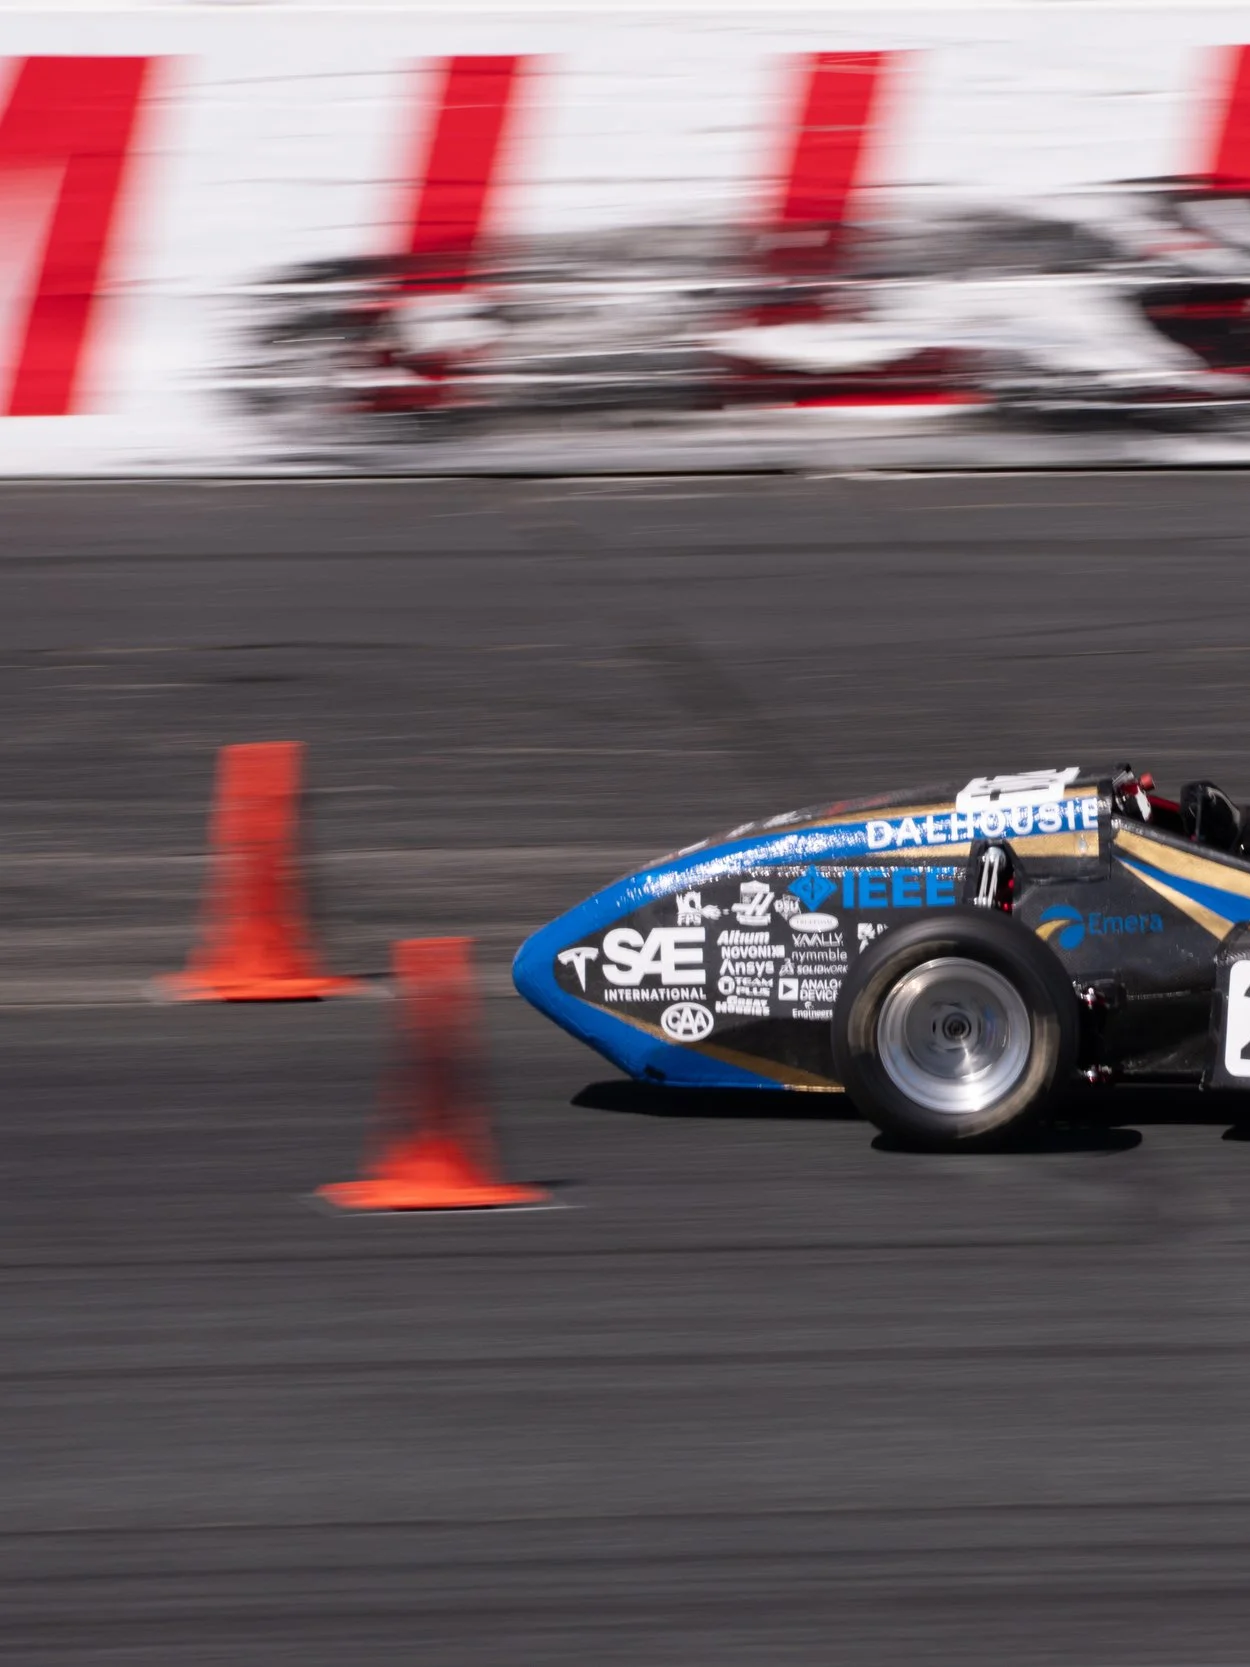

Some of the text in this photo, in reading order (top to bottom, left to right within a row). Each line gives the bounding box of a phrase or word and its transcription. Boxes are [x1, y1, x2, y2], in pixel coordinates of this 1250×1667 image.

[866, 797, 1100, 850] DALHOUSIE
[842, 867, 956, 909] IEEE
[1088, 912, 1164, 935] Emera
[717, 930, 770, 945] Altium
[602, 927, 706, 986] SAE
[721, 945, 784, 959] NOVONIX
[791, 948, 848, 963] nymmble
[720, 959, 774, 978] Ansys
[797, 964, 848, 975] SOLIDWORK
[734, 976, 773, 988] TEAM
[604, 987, 706, 1001] INTERNATIONAL
[666, 1005, 709, 1036] CAA
